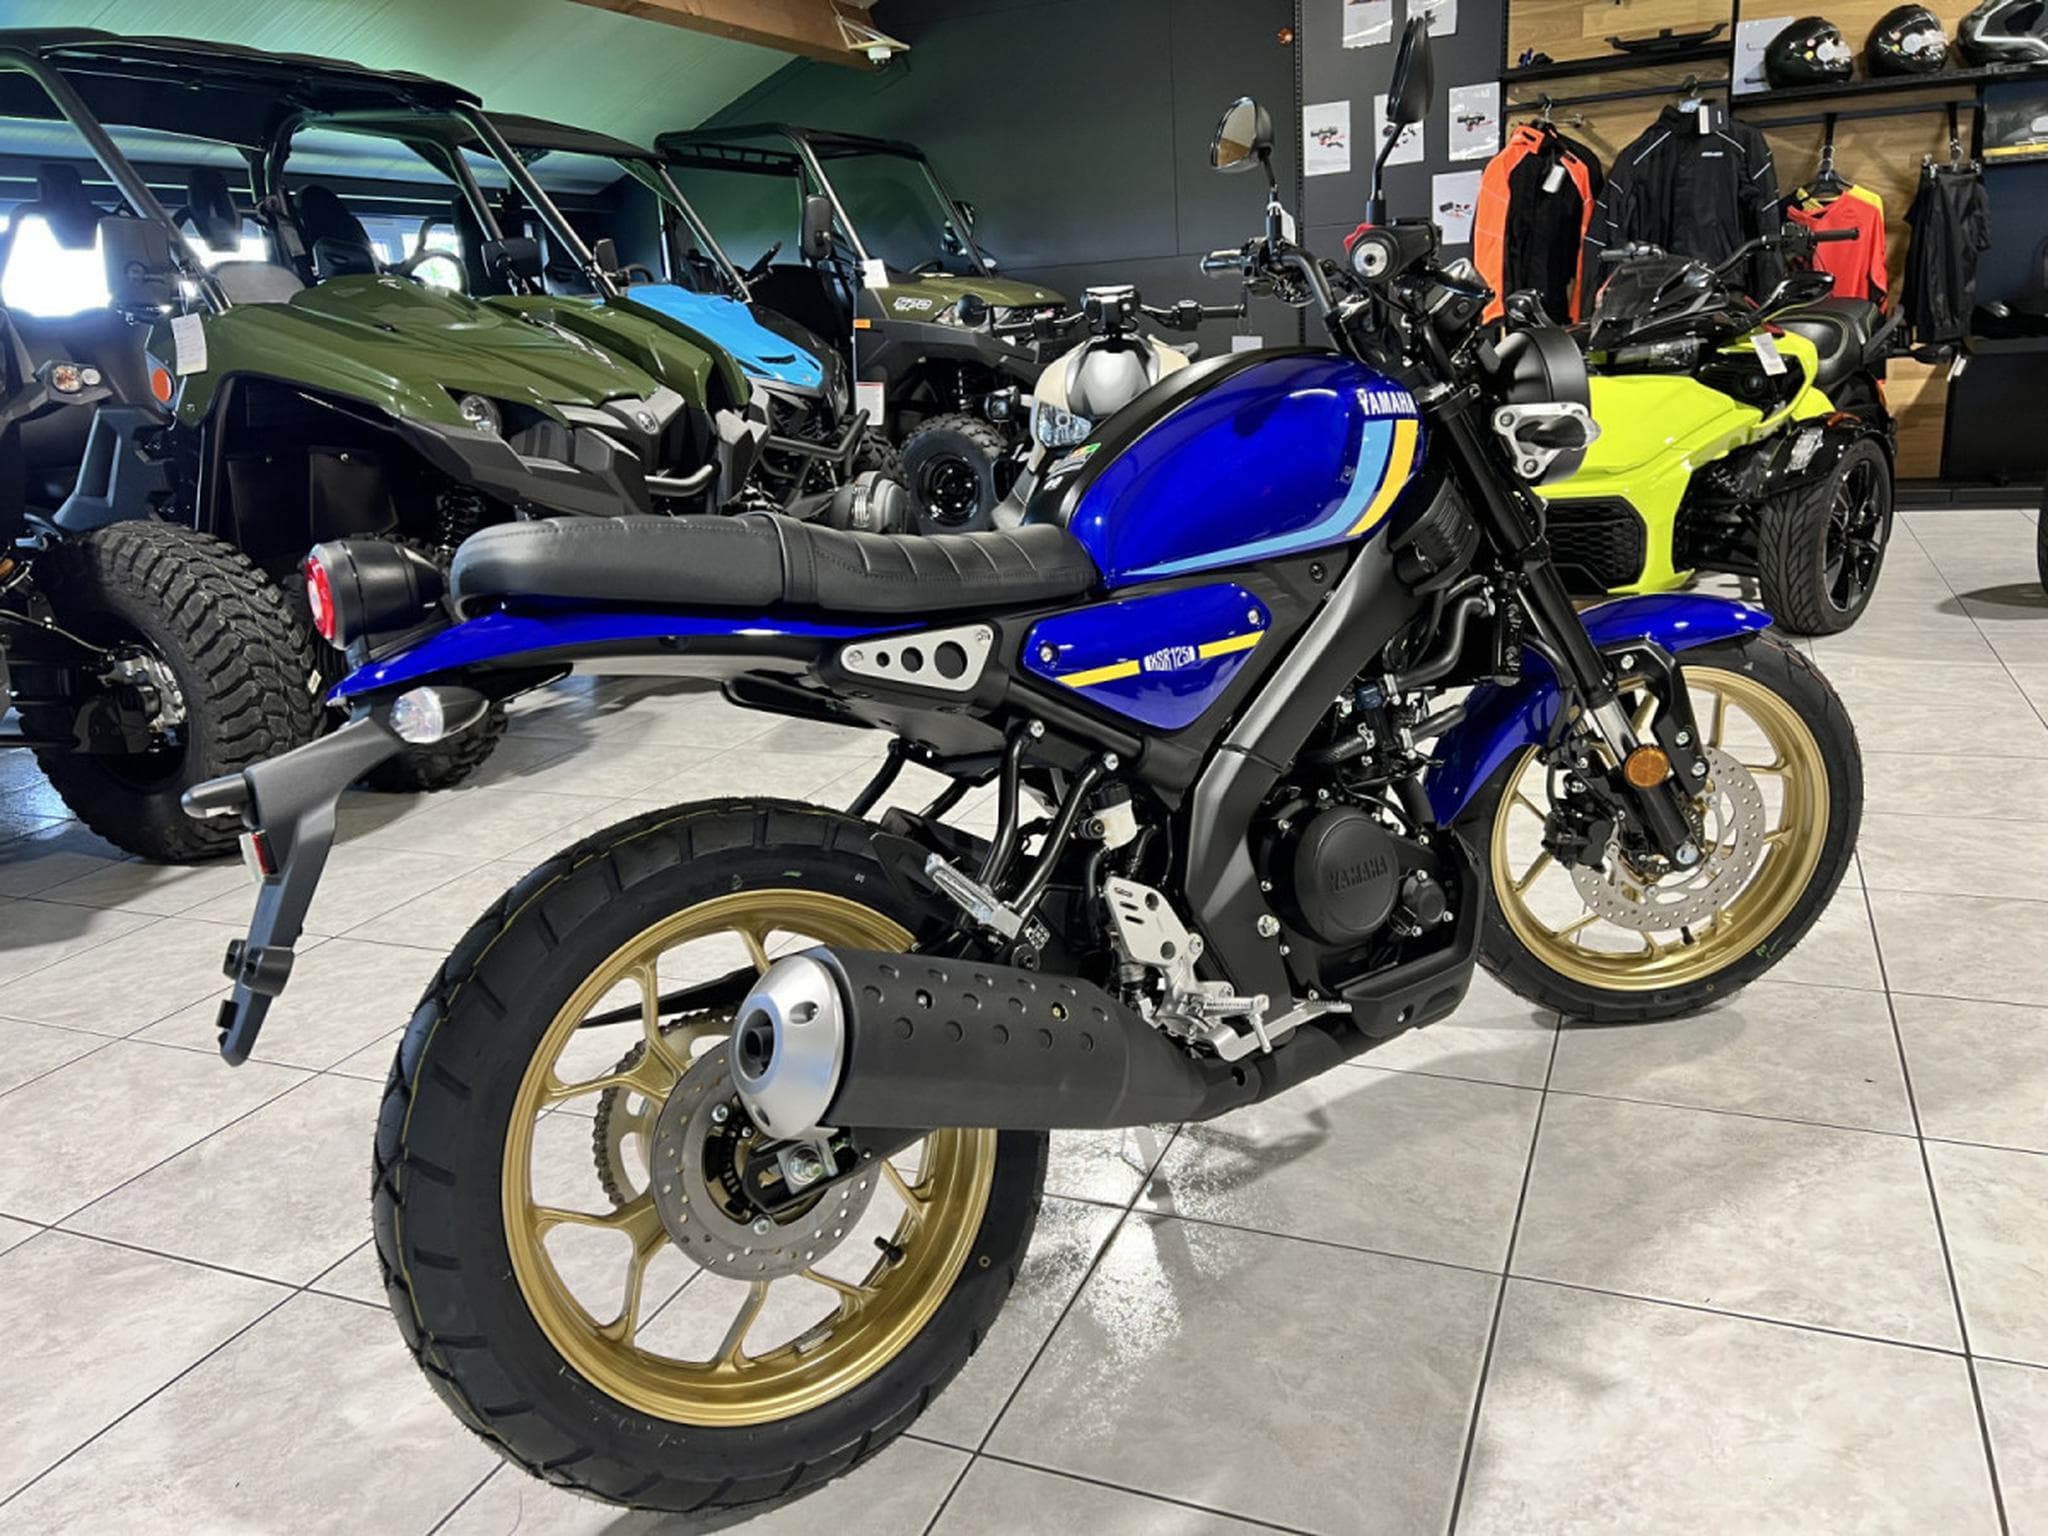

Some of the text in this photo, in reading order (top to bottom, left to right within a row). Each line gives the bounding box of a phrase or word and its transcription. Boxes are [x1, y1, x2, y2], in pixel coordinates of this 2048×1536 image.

[1356, 388, 1417, 416] YAMAHA
[1147, 645, 1194, 671] XSR125
[1328, 855, 1389, 892] YAMAHA
